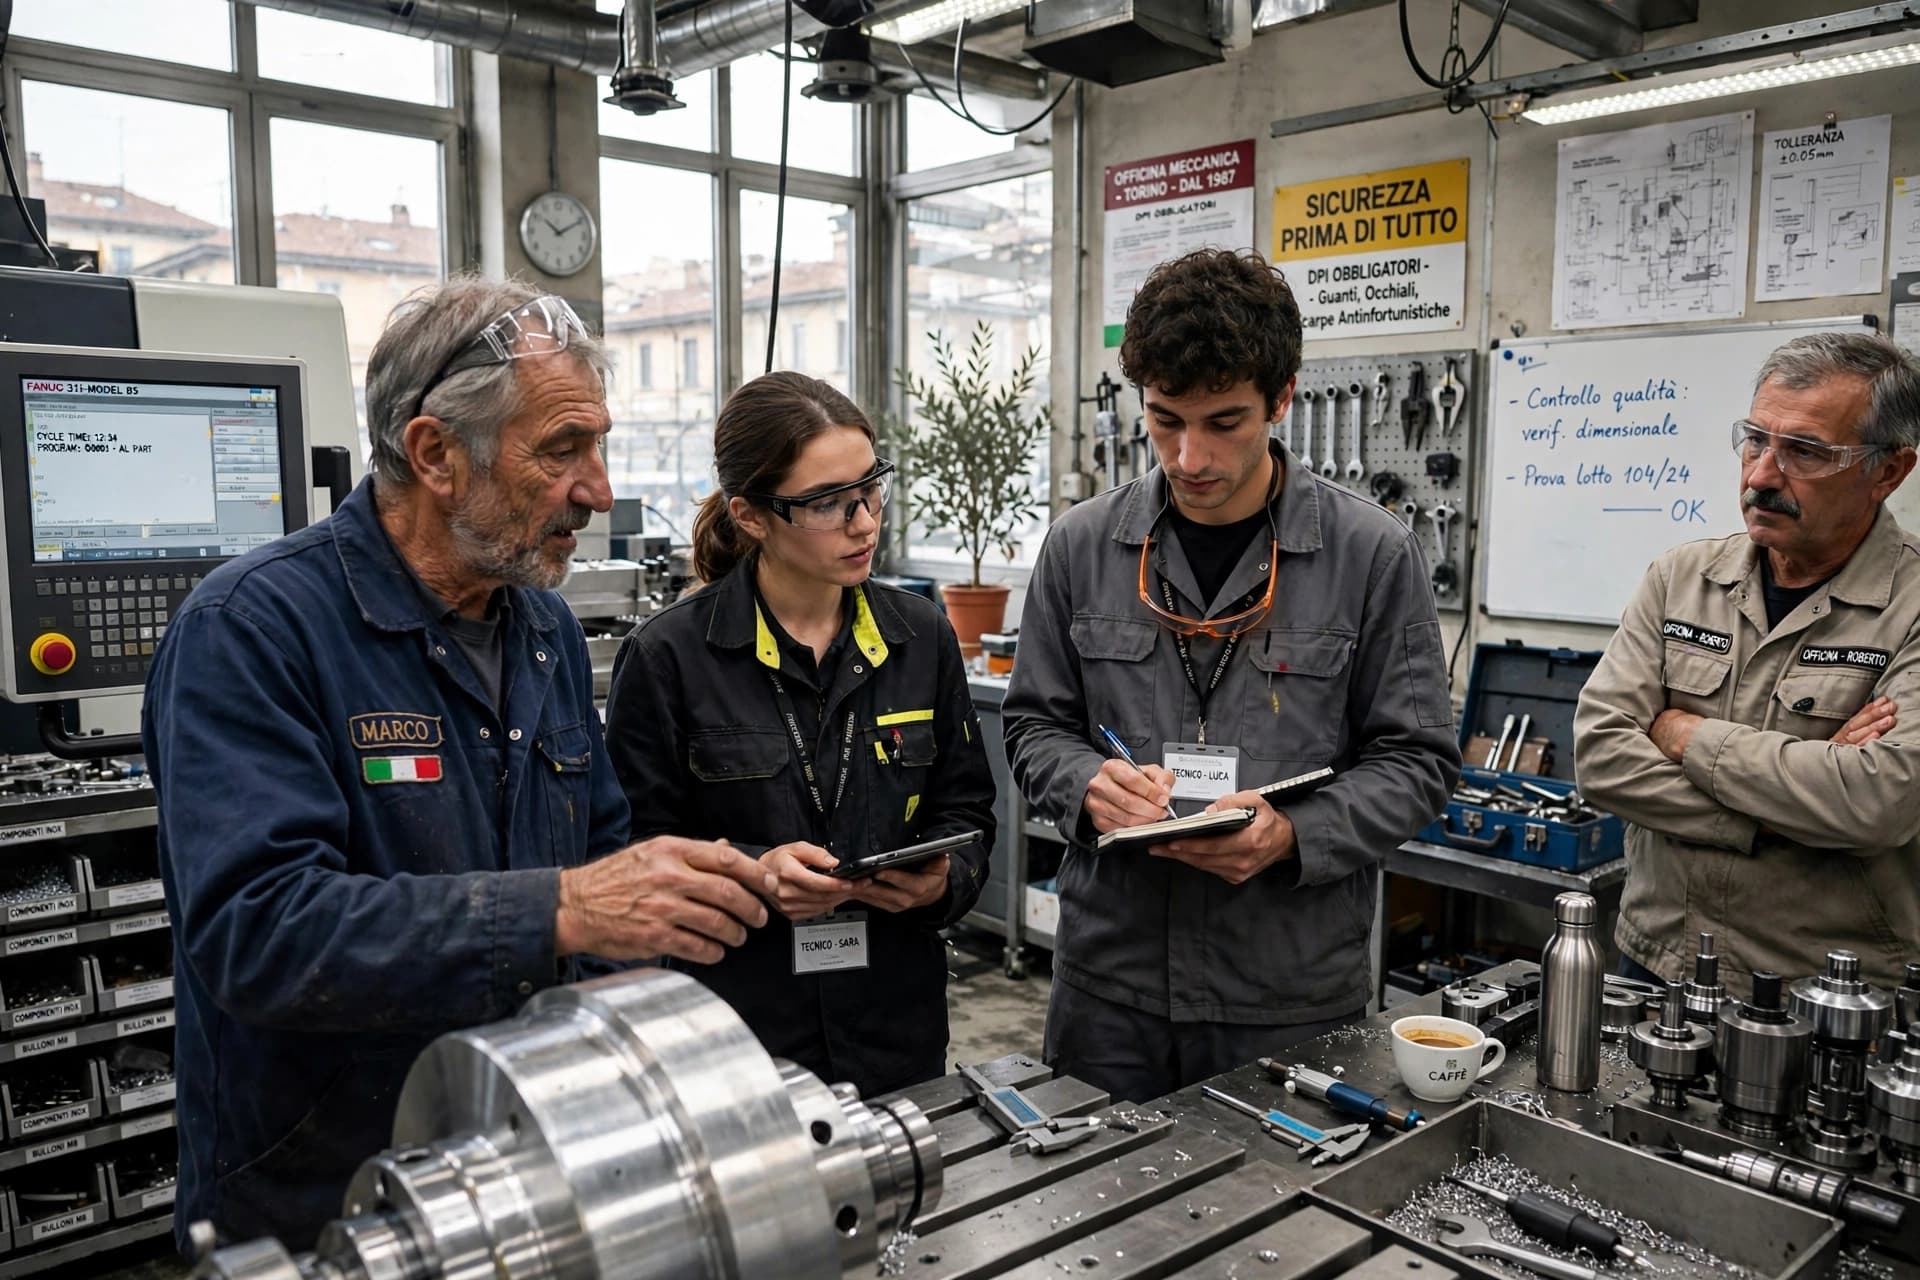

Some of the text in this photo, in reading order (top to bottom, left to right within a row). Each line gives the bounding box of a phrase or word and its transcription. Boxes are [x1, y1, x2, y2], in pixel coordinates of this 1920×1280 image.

[1774, 130, 1844, 149] TOLLERANZA
[1114, 151, 1240, 186] OFFICINA MECCANICA
[1124, 181, 1168, 201] TORINO
[1179, 175, 1203, 192] DAL
[1206, 169, 1236, 188] 1987
[1306, 178, 1431, 218] SICUREZZA
[1281, 207, 1457, 252] PRIMA DI TUTTO
[1308, 268, 1329, 285] DPI
[1332, 258, 1421, 281] OBBLIGATORI
[1318, 286, 1361, 304] Guanti,
[1365, 281, 1419, 300] Occhiali,
[1301, 303, 1451, 331] carpe Antinfortunistiche
[26, 382, 64, 392] FANUC
[1527, 384, 1601, 409] Controllo
[36, 432, 64, 442] CYCLE
[1522, 412, 1679, 450] verif. dimensionale
[118, 444, 129, 453] AL
[132, 444, 152, 453] PART
[1524, 464, 1566, 486] Prova
[1577, 463, 1613, 485] lotto
[1624, 457, 1691, 491] 104/24
[1671, 499, 1707, 523] OK
[1846, 650, 1887, 667] ROBERTO
[360, 720, 429, 742] MARCO
[1171, 768, 1202, 779] TECNICO
[1208, 770, 1229, 781] LUCA
[0, 827, 43, 841] OMPONENTI
[800, 939, 833, 952] TECNICO
[838, 936, 860, 948] SARA
[1428, 1067, 1468, 1081] CAFFÈ
